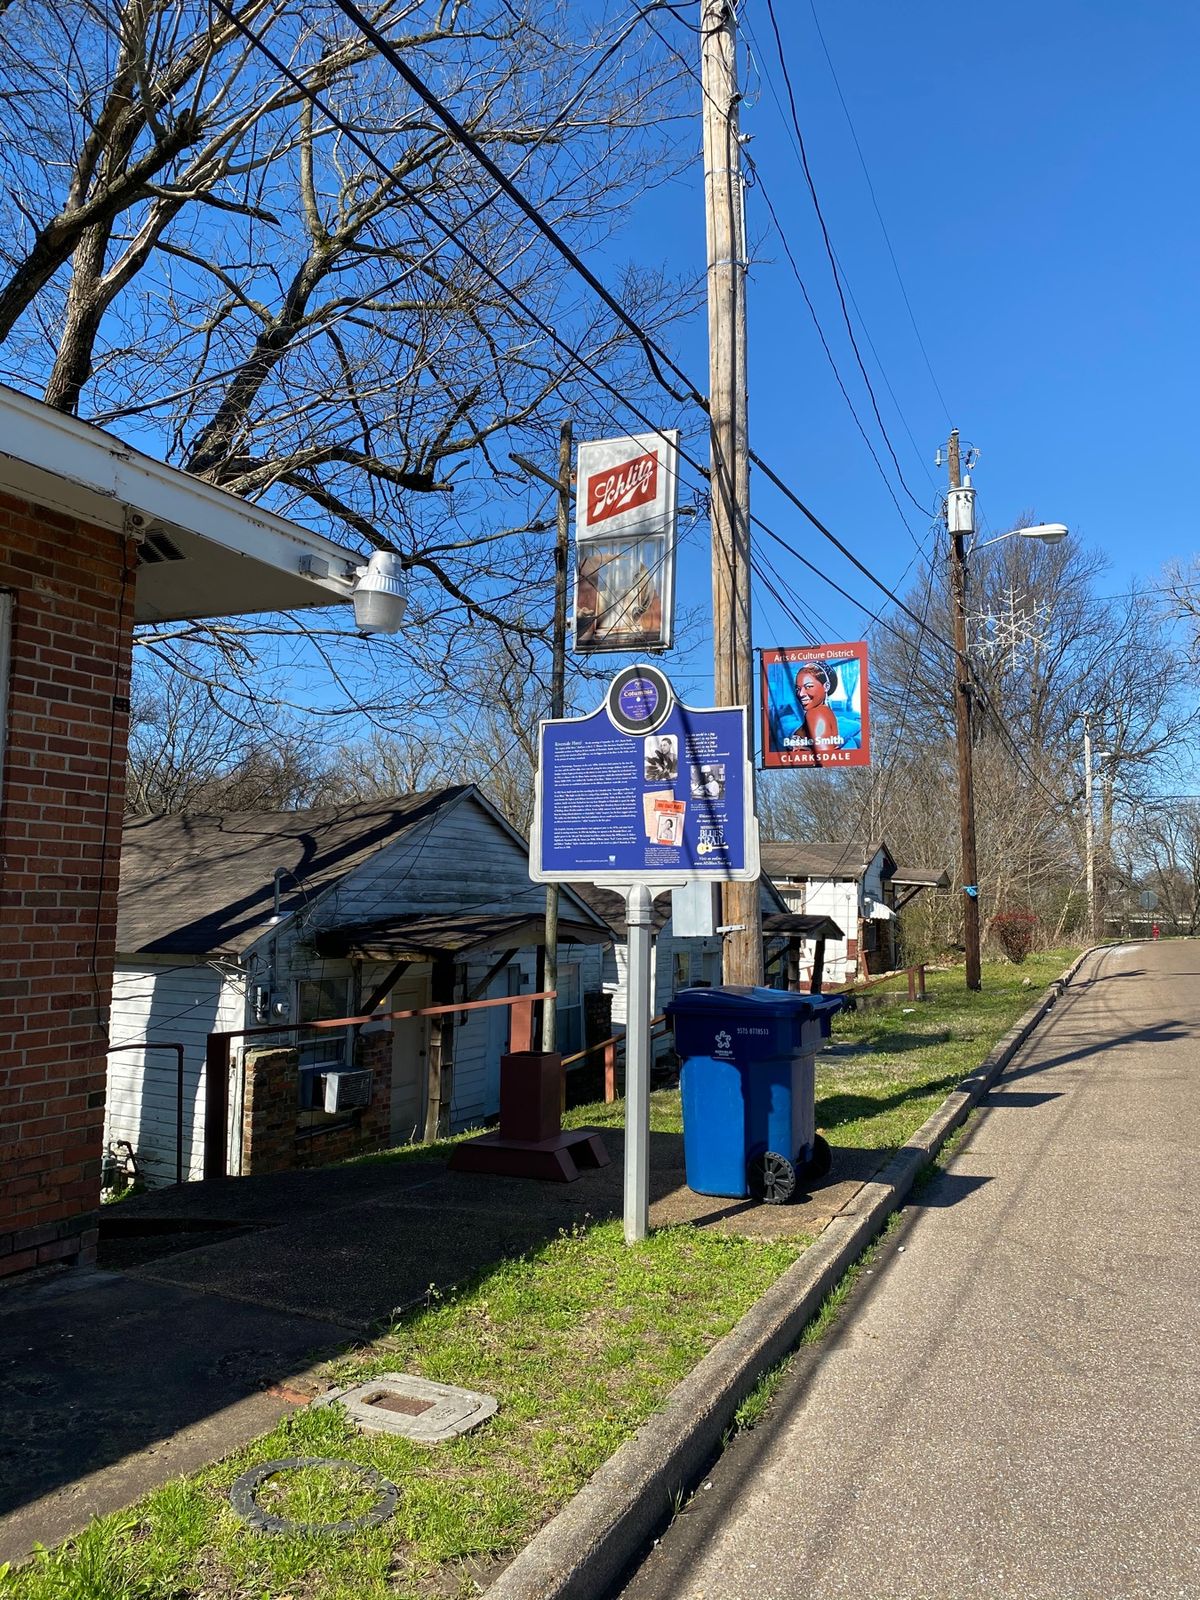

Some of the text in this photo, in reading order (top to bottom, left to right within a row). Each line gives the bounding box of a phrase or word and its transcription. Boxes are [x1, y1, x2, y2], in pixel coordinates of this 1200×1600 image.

[592, 458, 653, 517] Schlitz
[774, 654, 789, 662] Arts
[797, 651, 825, 660] Culture
[826, 649, 855, 658] District
[783, 734, 845, 747] Bessie Smith
[781, 752, 851, 763] CLARKSDALE
[700, 829, 724, 838] BLUES
[698, 836, 726, 846] TRAIL
